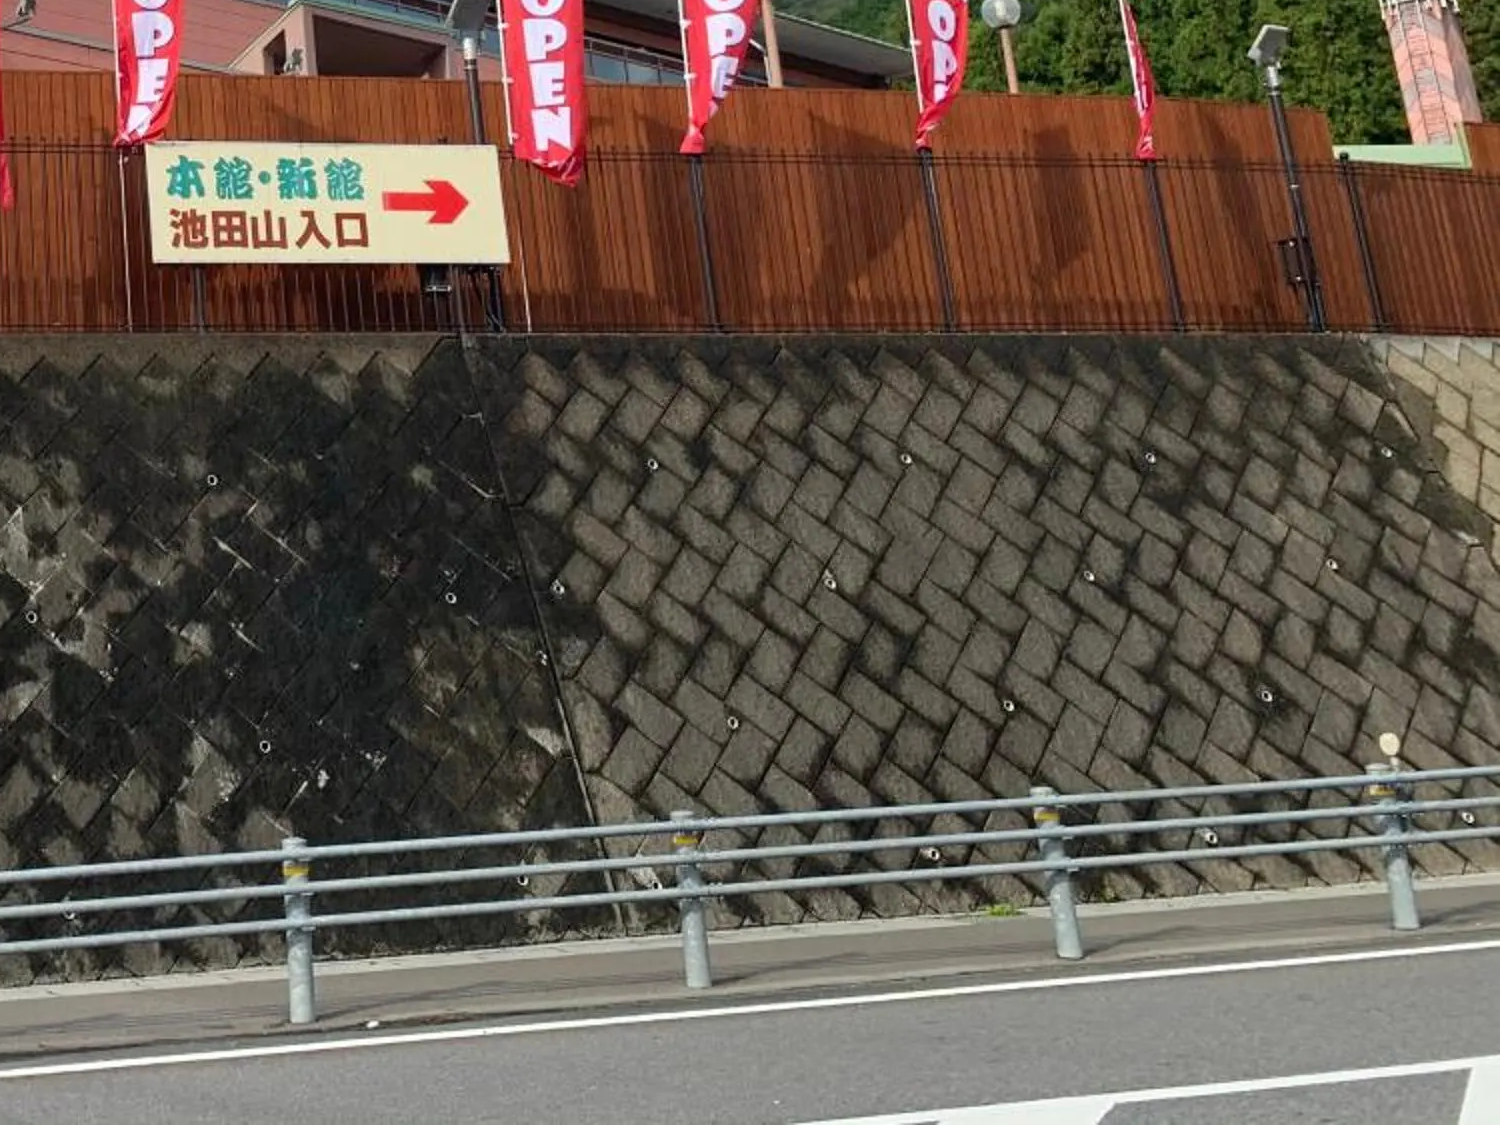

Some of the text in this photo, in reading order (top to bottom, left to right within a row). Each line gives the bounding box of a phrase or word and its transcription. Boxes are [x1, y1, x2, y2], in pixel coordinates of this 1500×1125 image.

[927, 0, 957, 104] OP
[166, 156, 364, 201] 本館・新館
[170, 208, 370, 250] 池田山入口
